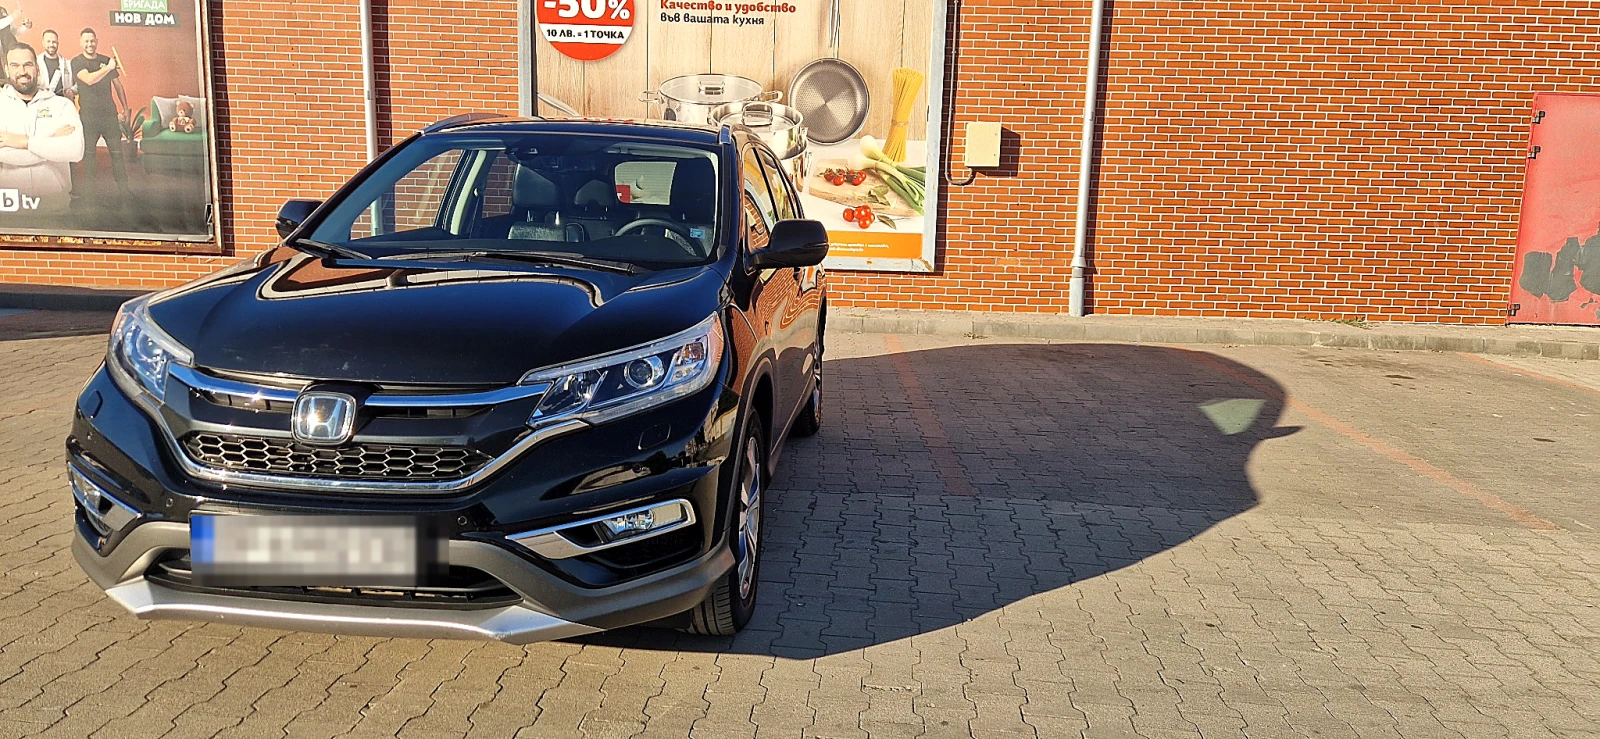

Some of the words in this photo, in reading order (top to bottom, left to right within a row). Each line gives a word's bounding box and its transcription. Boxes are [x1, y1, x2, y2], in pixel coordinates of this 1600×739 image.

[123, 0, 166, 10] БРИГАДА
[543, 0, 631, 20] -50%
[660, 0, 723, 10] Качество
[725, 3, 732, 11] и
[734, 2, 797, 14] удобство
[114, 12, 142, 24] НОВ
[144, 13, 175, 26] ДОМ
[660, 12, 681, 22] във
[683, 13, 730, 24] вашата
[732, 14, 765, 27] кухня
[546, 29, 557, 37] 10
[559, 29, 576, 38] ЛВ.
[590, 30, 625, 39] ТОЧКА
